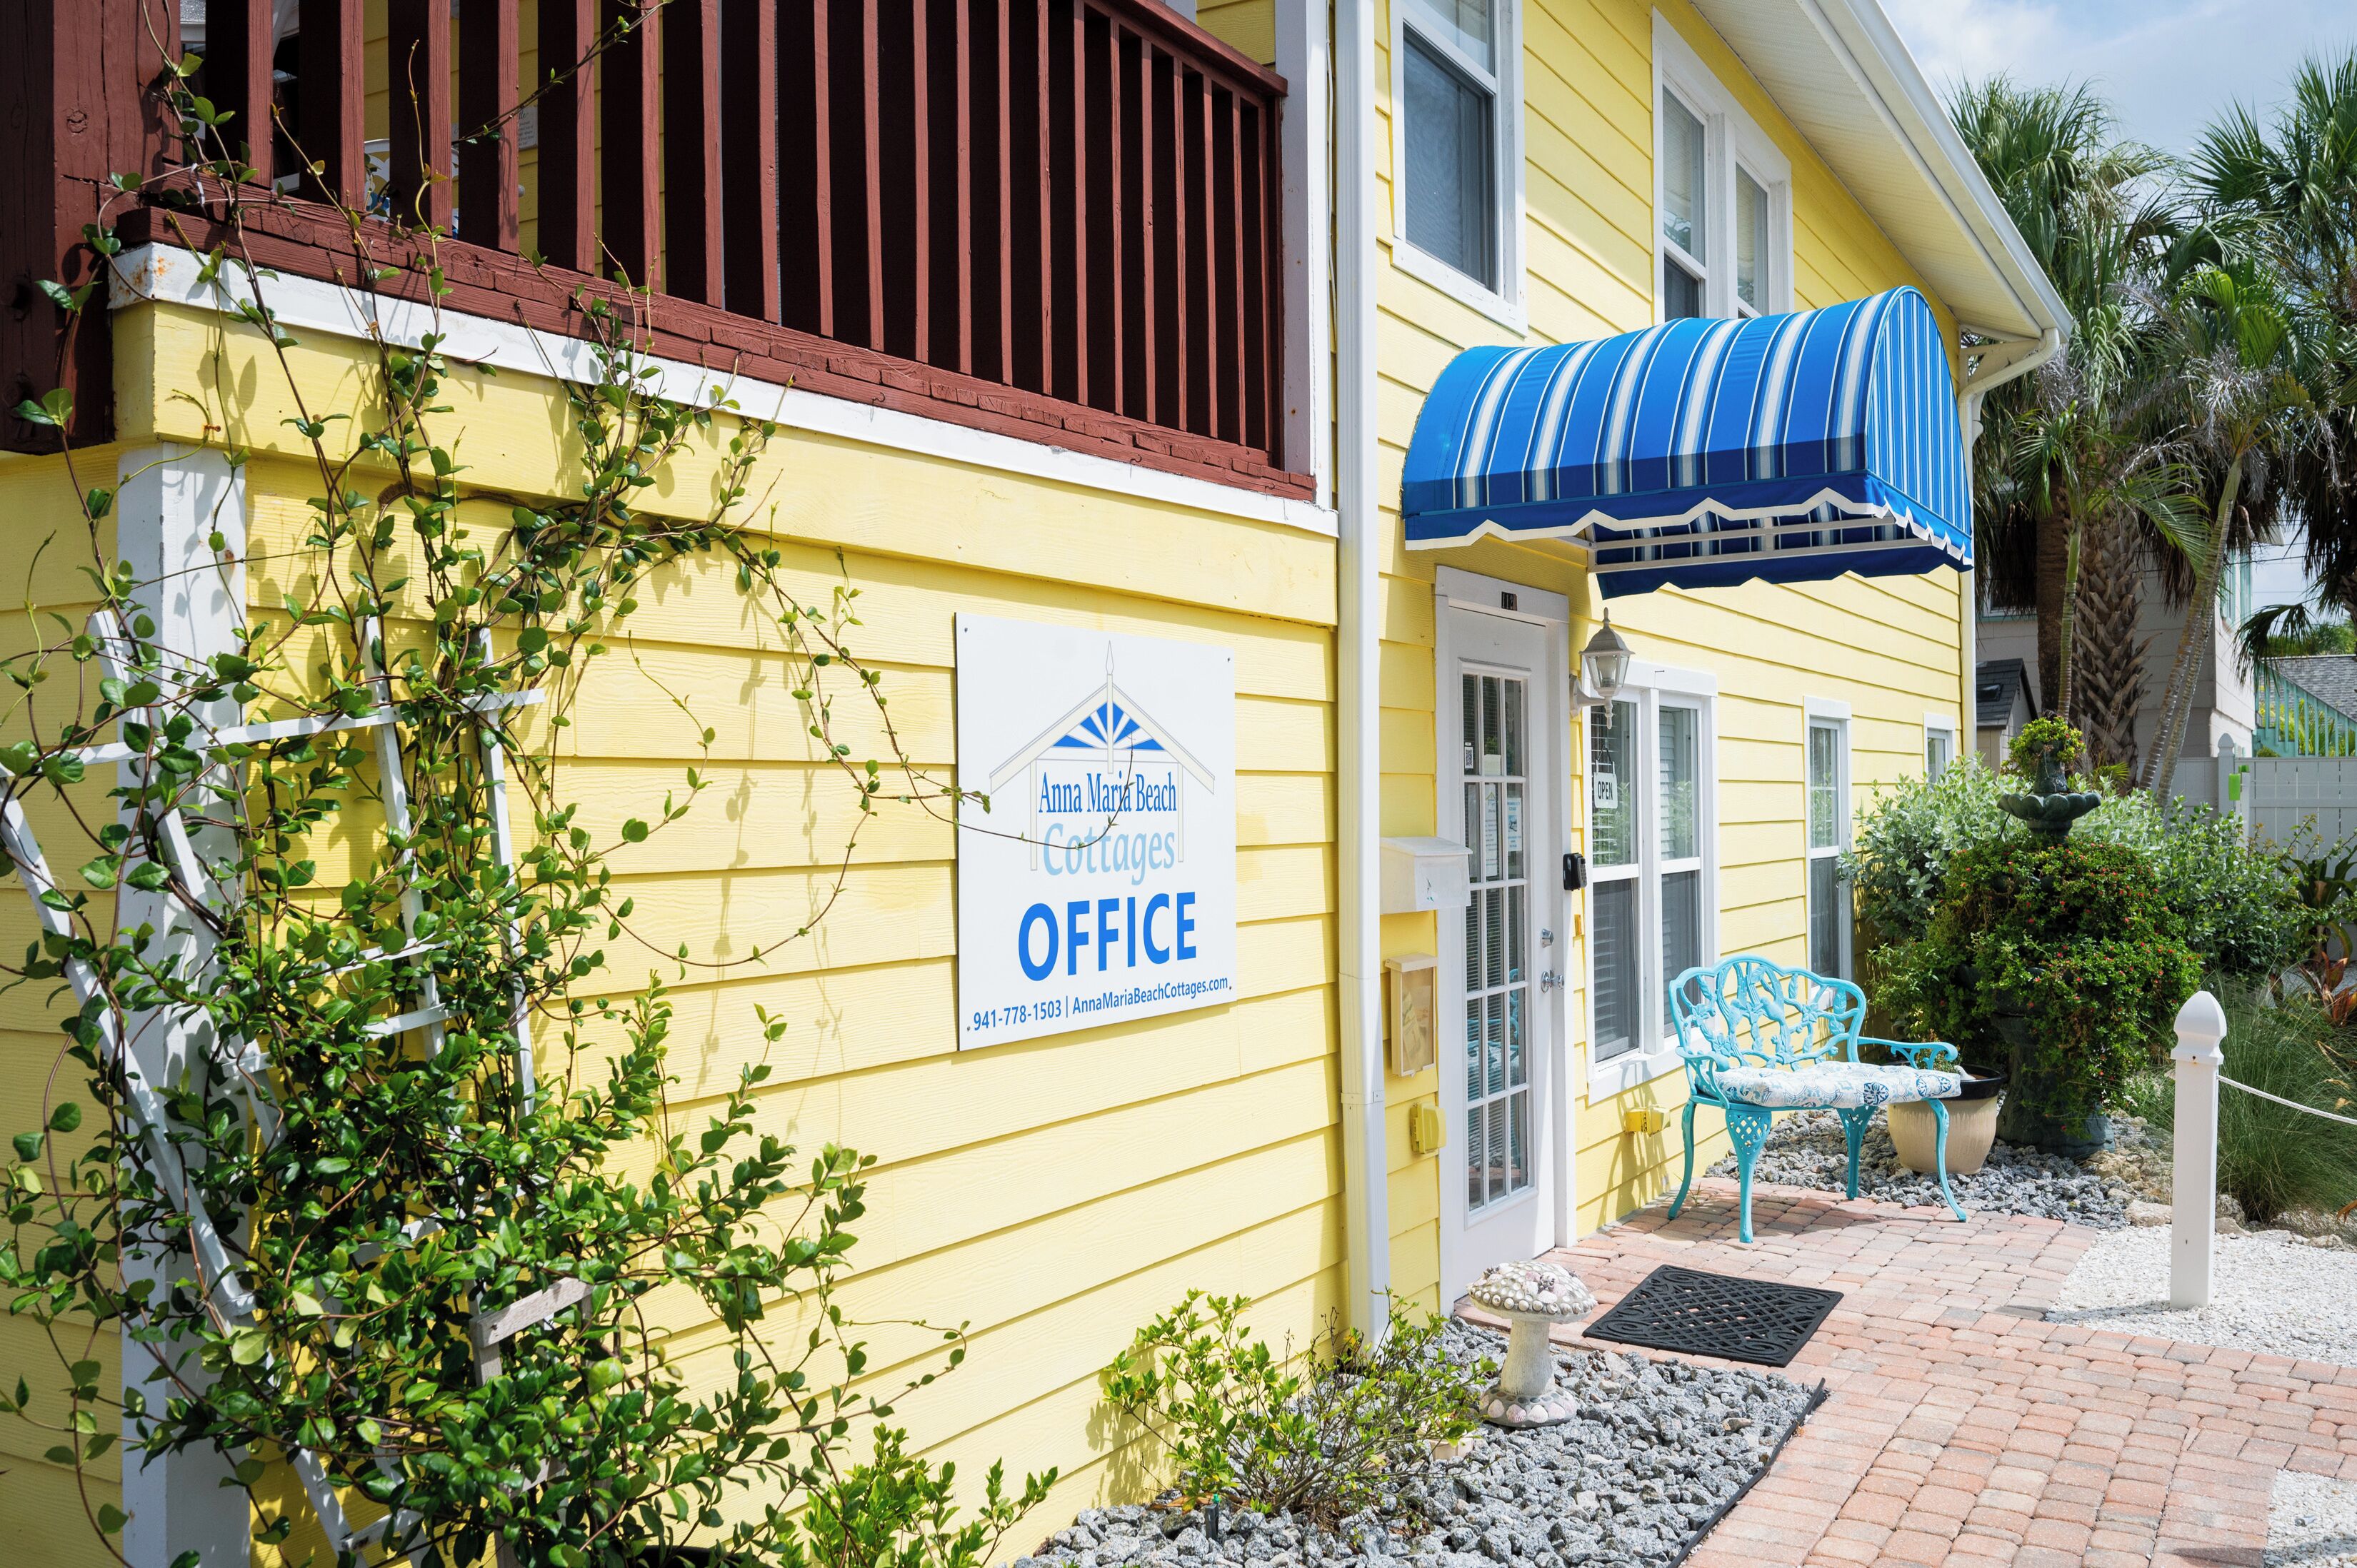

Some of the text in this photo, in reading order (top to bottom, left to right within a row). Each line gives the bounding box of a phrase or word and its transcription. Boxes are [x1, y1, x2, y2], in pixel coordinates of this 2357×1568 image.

[1039, 770, 1177, 813] Anna Maria Beach
[1597, 780, 1613, 800] OPEN
[1043, 823, 1176, 886] Cottages
[1018, 891, 1197, 982] OFFICE
[973, 975, 1228, 1031] 941-778-1503 AnnaMariaBeachCottages.com
